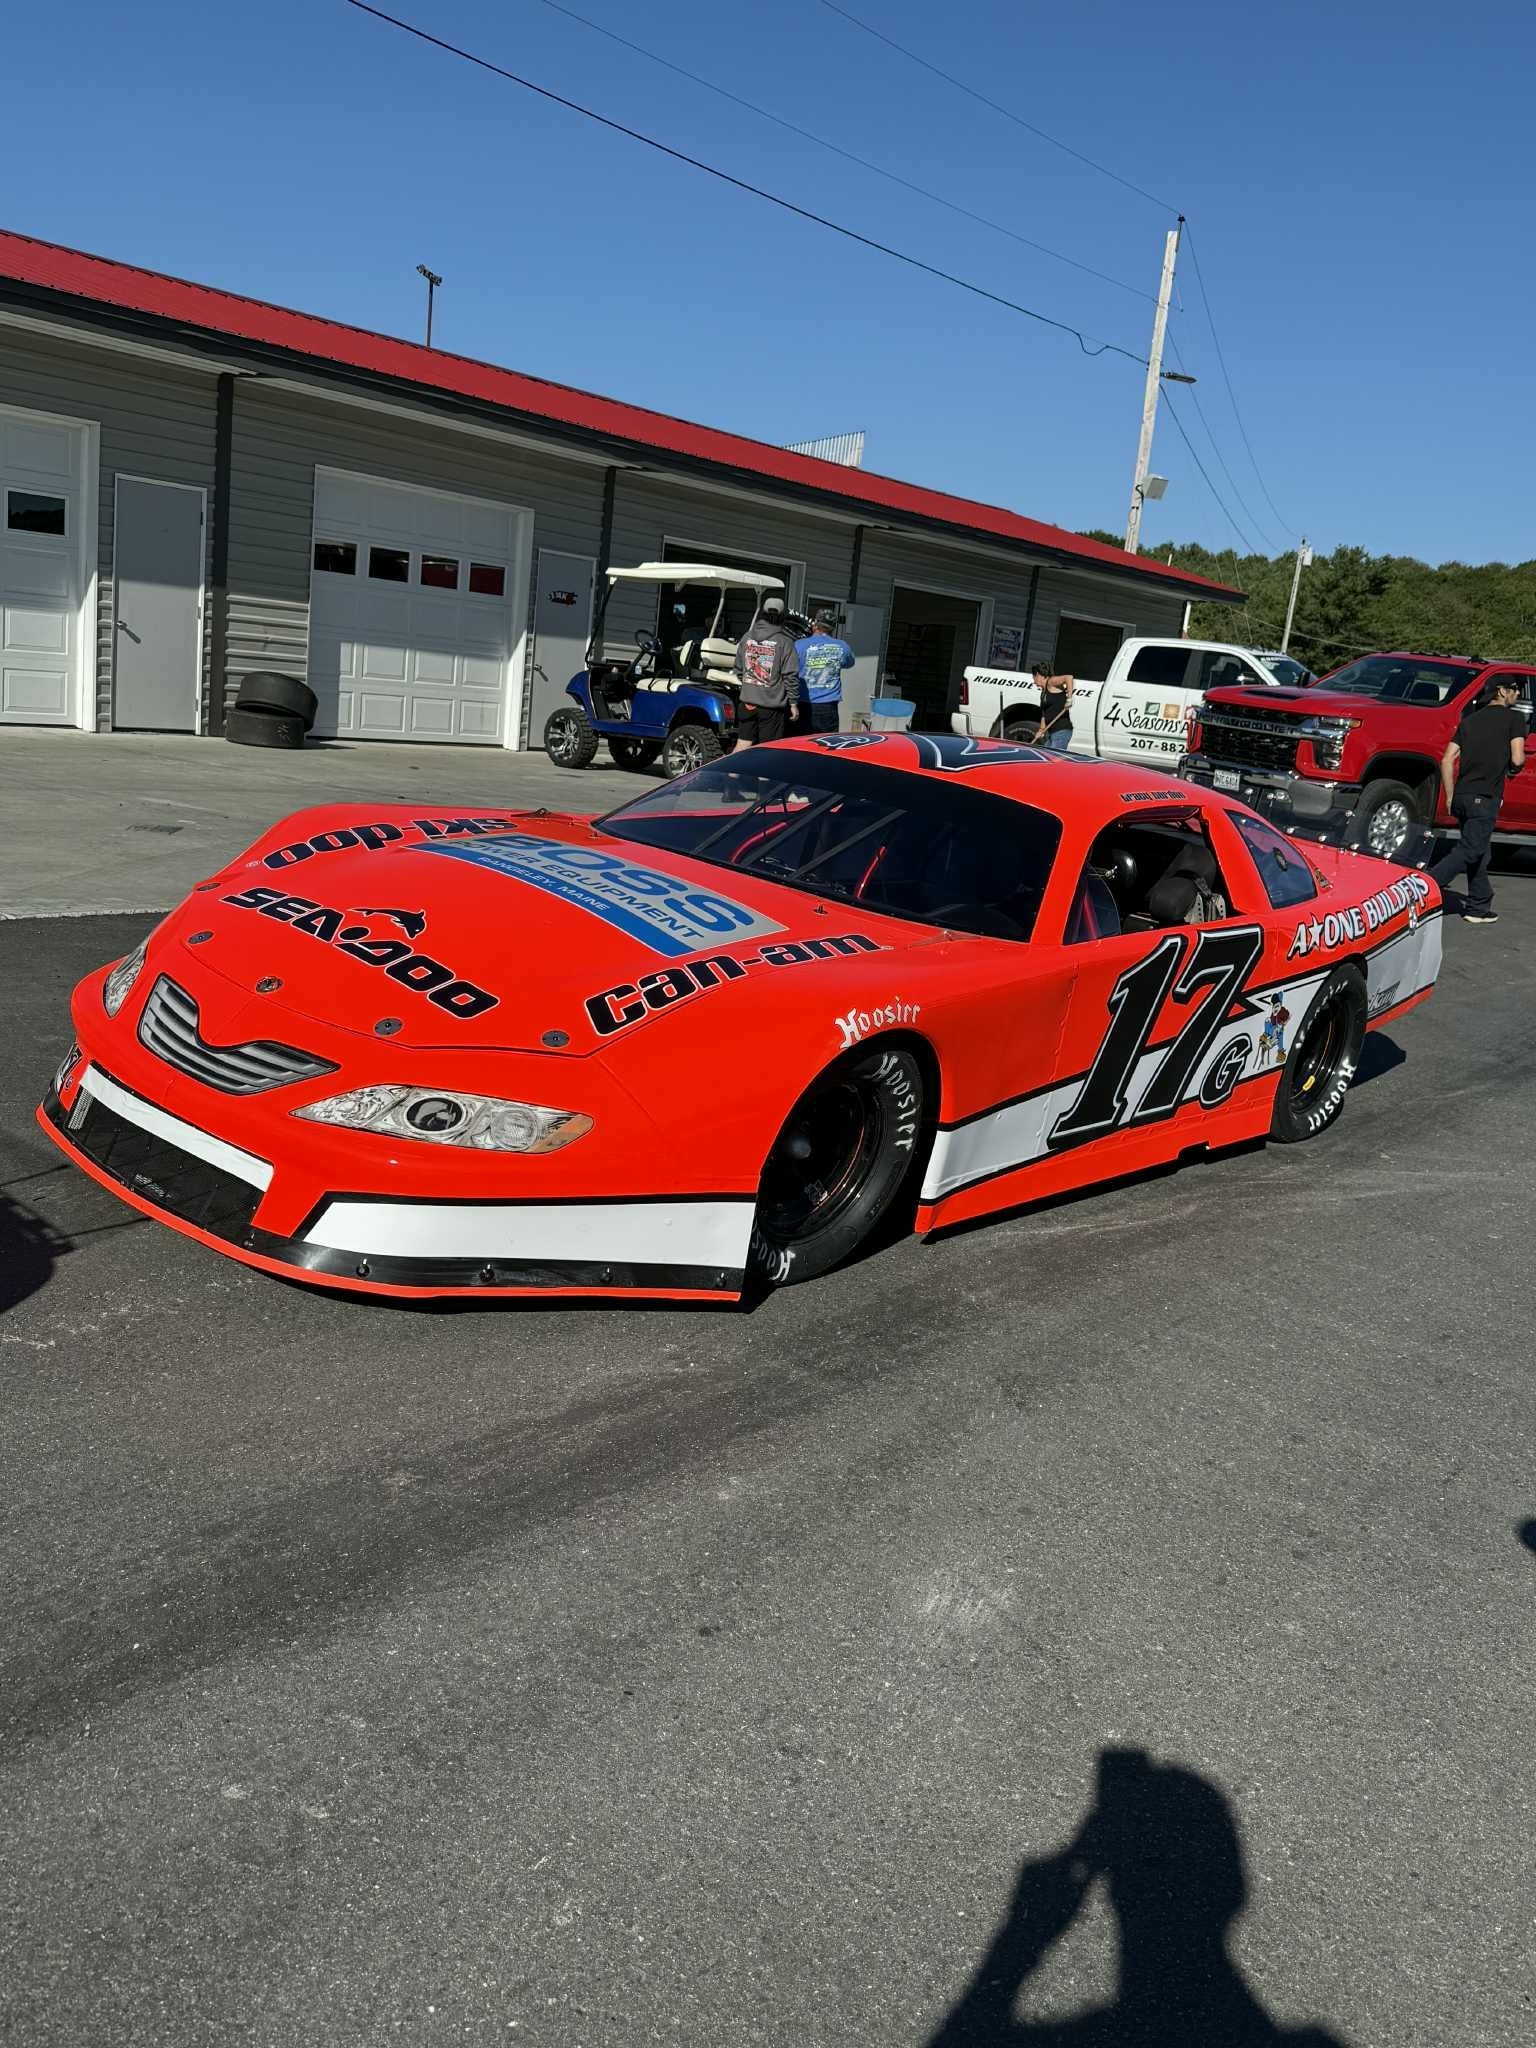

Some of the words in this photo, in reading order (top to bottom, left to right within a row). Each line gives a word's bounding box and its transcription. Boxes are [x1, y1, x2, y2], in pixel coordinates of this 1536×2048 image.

[973, 675, 1033, 690] ROADSIDE
[1103, 702, 1121, 727] 4
[446, 839, 539, 867] POWER
[543, 864, 705, 939] EQUIPMENT
[480, 835, 756, 933] BOSS
[559, 885, 609, 913] MAINE
[1362, 873, 1430, 933] BUILDERS
[834, 996, 921, 1050] Hoosier
[1047, 925, 1264, 1150] 17
[1200, 1033, 1252, 1109] G
[1308, 1056, 1357, 1132] Hoosier
